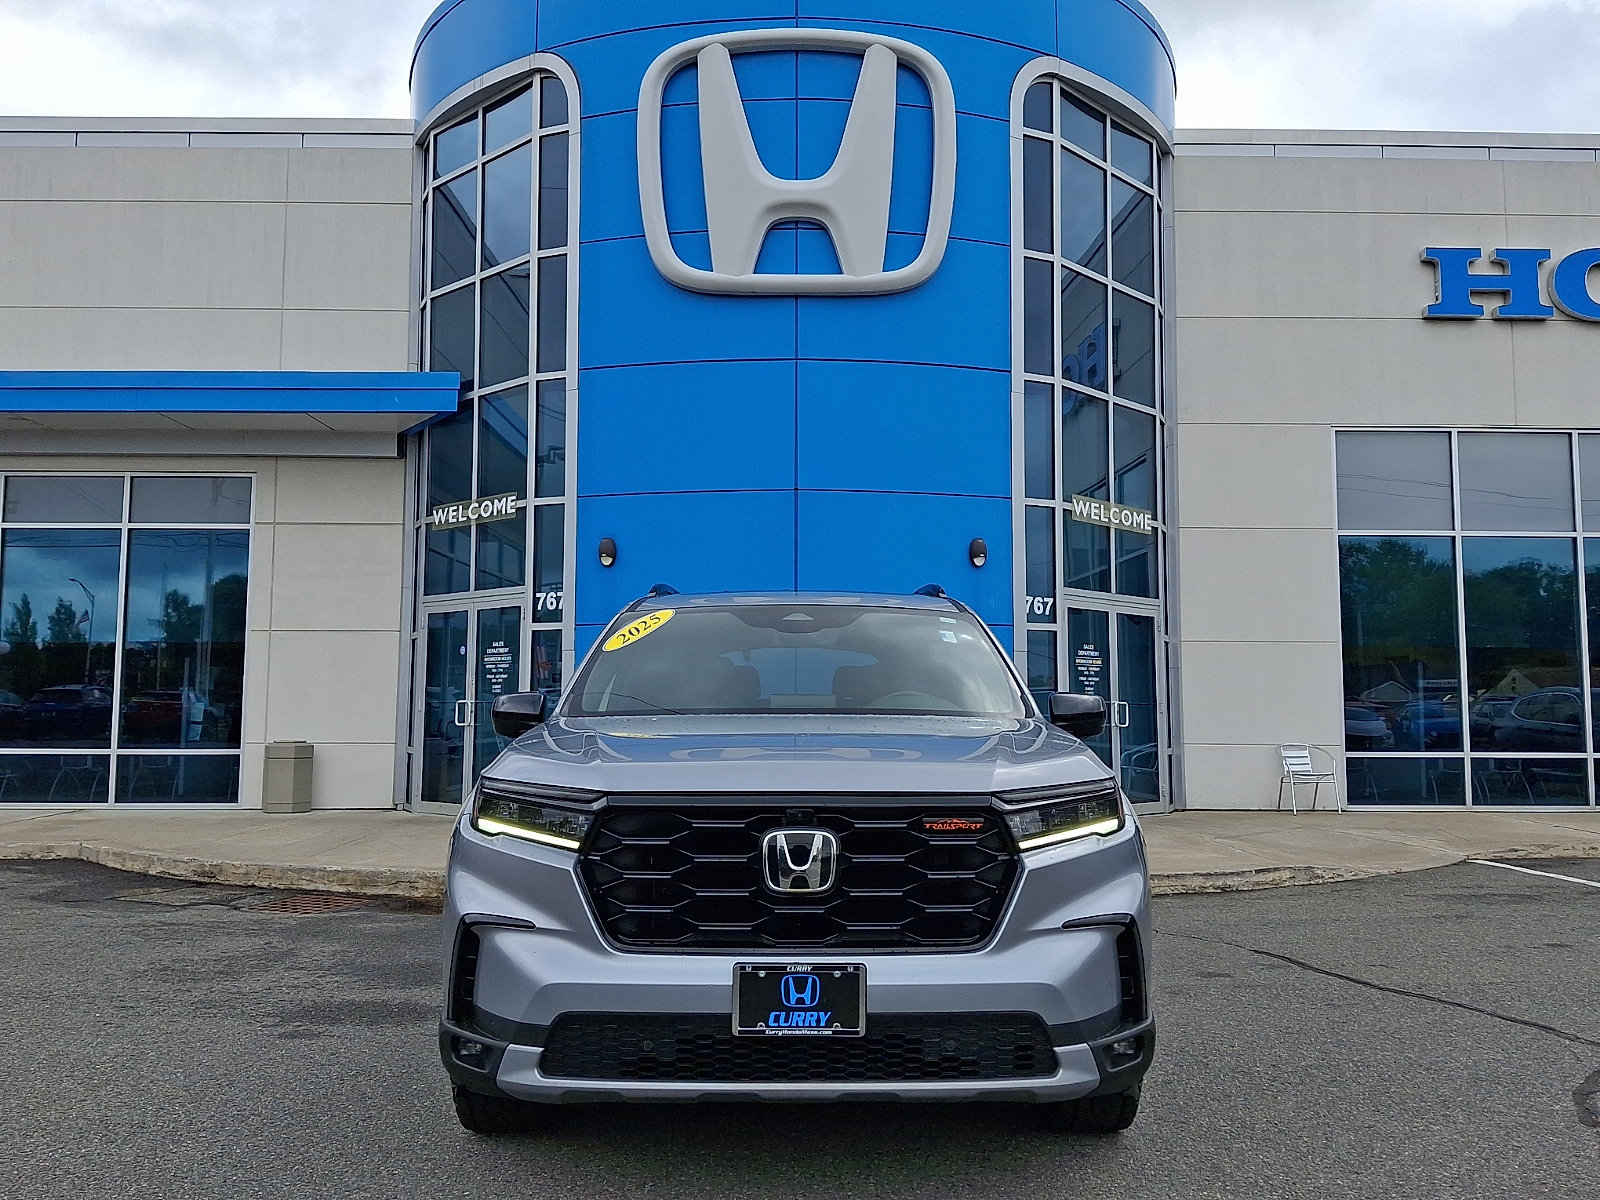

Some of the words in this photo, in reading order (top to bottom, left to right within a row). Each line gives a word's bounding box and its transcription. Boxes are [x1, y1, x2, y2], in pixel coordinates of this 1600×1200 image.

[432, 495, 517, 526] WELCOME
[1072, 498, 1152, 531] WELCOME
[535, 591, 564, 611] 767
[1025, 595, 1054, 616] 767
[615, 613, 661, 645] 2025
[768, 1011, 832, 1027] CURRY
